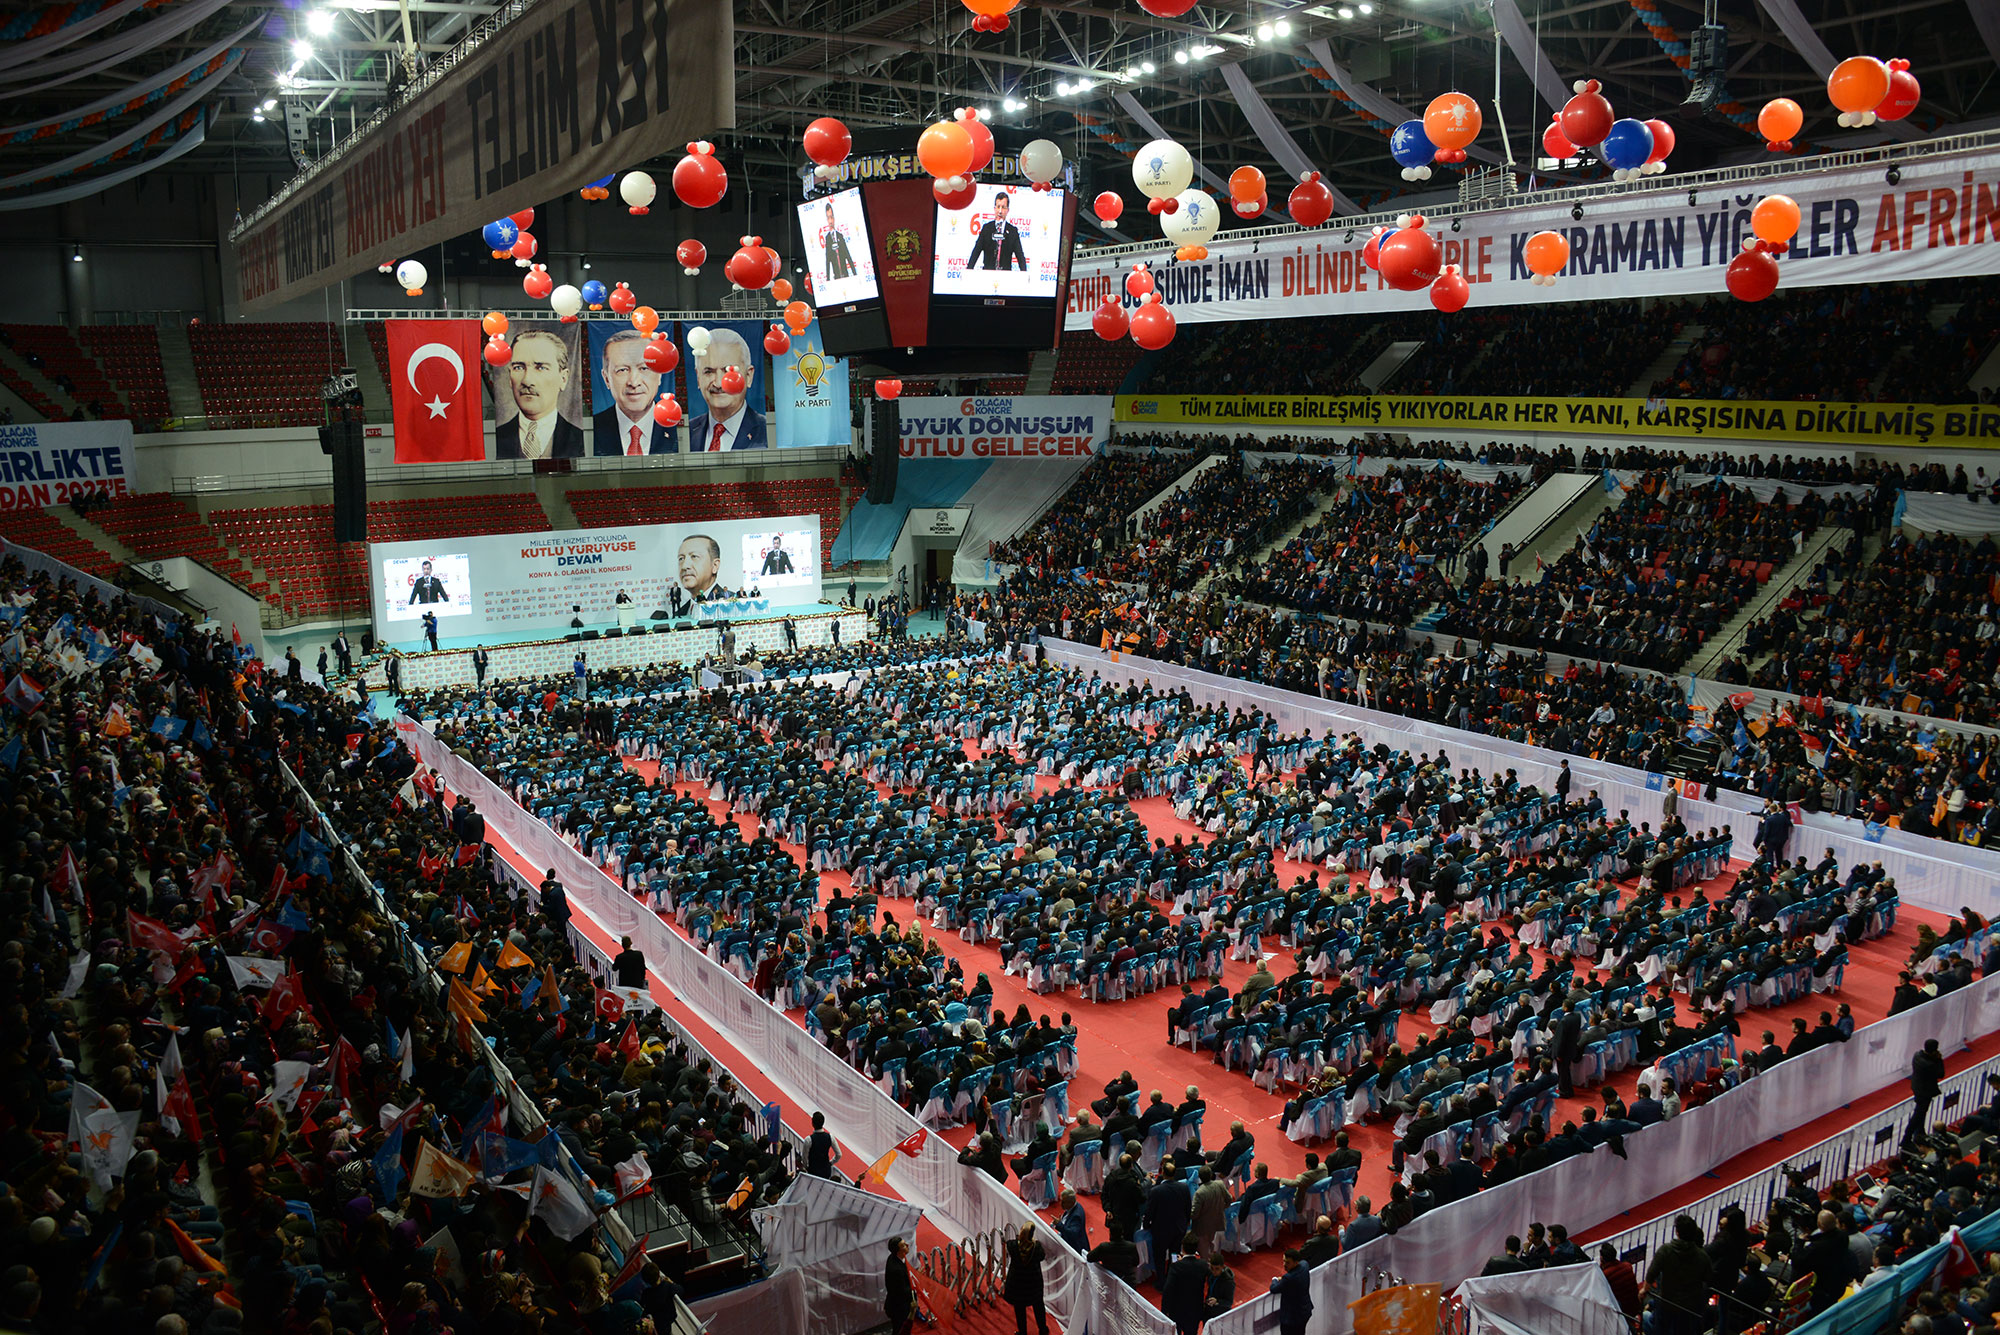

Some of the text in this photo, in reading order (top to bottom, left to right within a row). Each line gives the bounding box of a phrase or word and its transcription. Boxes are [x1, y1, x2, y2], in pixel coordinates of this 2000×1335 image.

[1219, 255, 1269, 301] İMAN
[1282, 244, 1367, 297] DİLİNDE
[1510, 216, 1685, 281] KRAMAN
[794, 400, 806, 408] AK
[975, 397, 1012, 407] OLAĞAN
[975, 406, 1012, 415] KONGRE
[969, 415, 1094, 436] DÖNÜŞÜM
[1181, 397, 1210, 417] TÜM
[1215, 397, 1287, 418] ZALİMLER
[1294, 397, 1381, 423] BİRLEŞMİŞ
[1388, 401, 1507, 422] YIKIYORLAR
[1514, 403, 1558, 423] HER
[1566, 403, 1629, 428] YANI,
[1795, 403, 1935, 442] DİKİLMİŞ
[1944, 406, 2000, 437] BİR
[971, 436, 1094, 457] GELECEK
[0, 447, 124, 483] İRLİKTE
[530, 534, 628, 547] MİLLETE HİZMET YOLUNDA
[521, 541, 636, 558] KUTLU YÜRÜYÜŞE
[557, 554, 603, 566] DEVAM
[529, 571, 552, 579] KONYA
[561, 567, 590, 576] OLAĞAN
[598, 564, 632, 573] KONGRESİ
